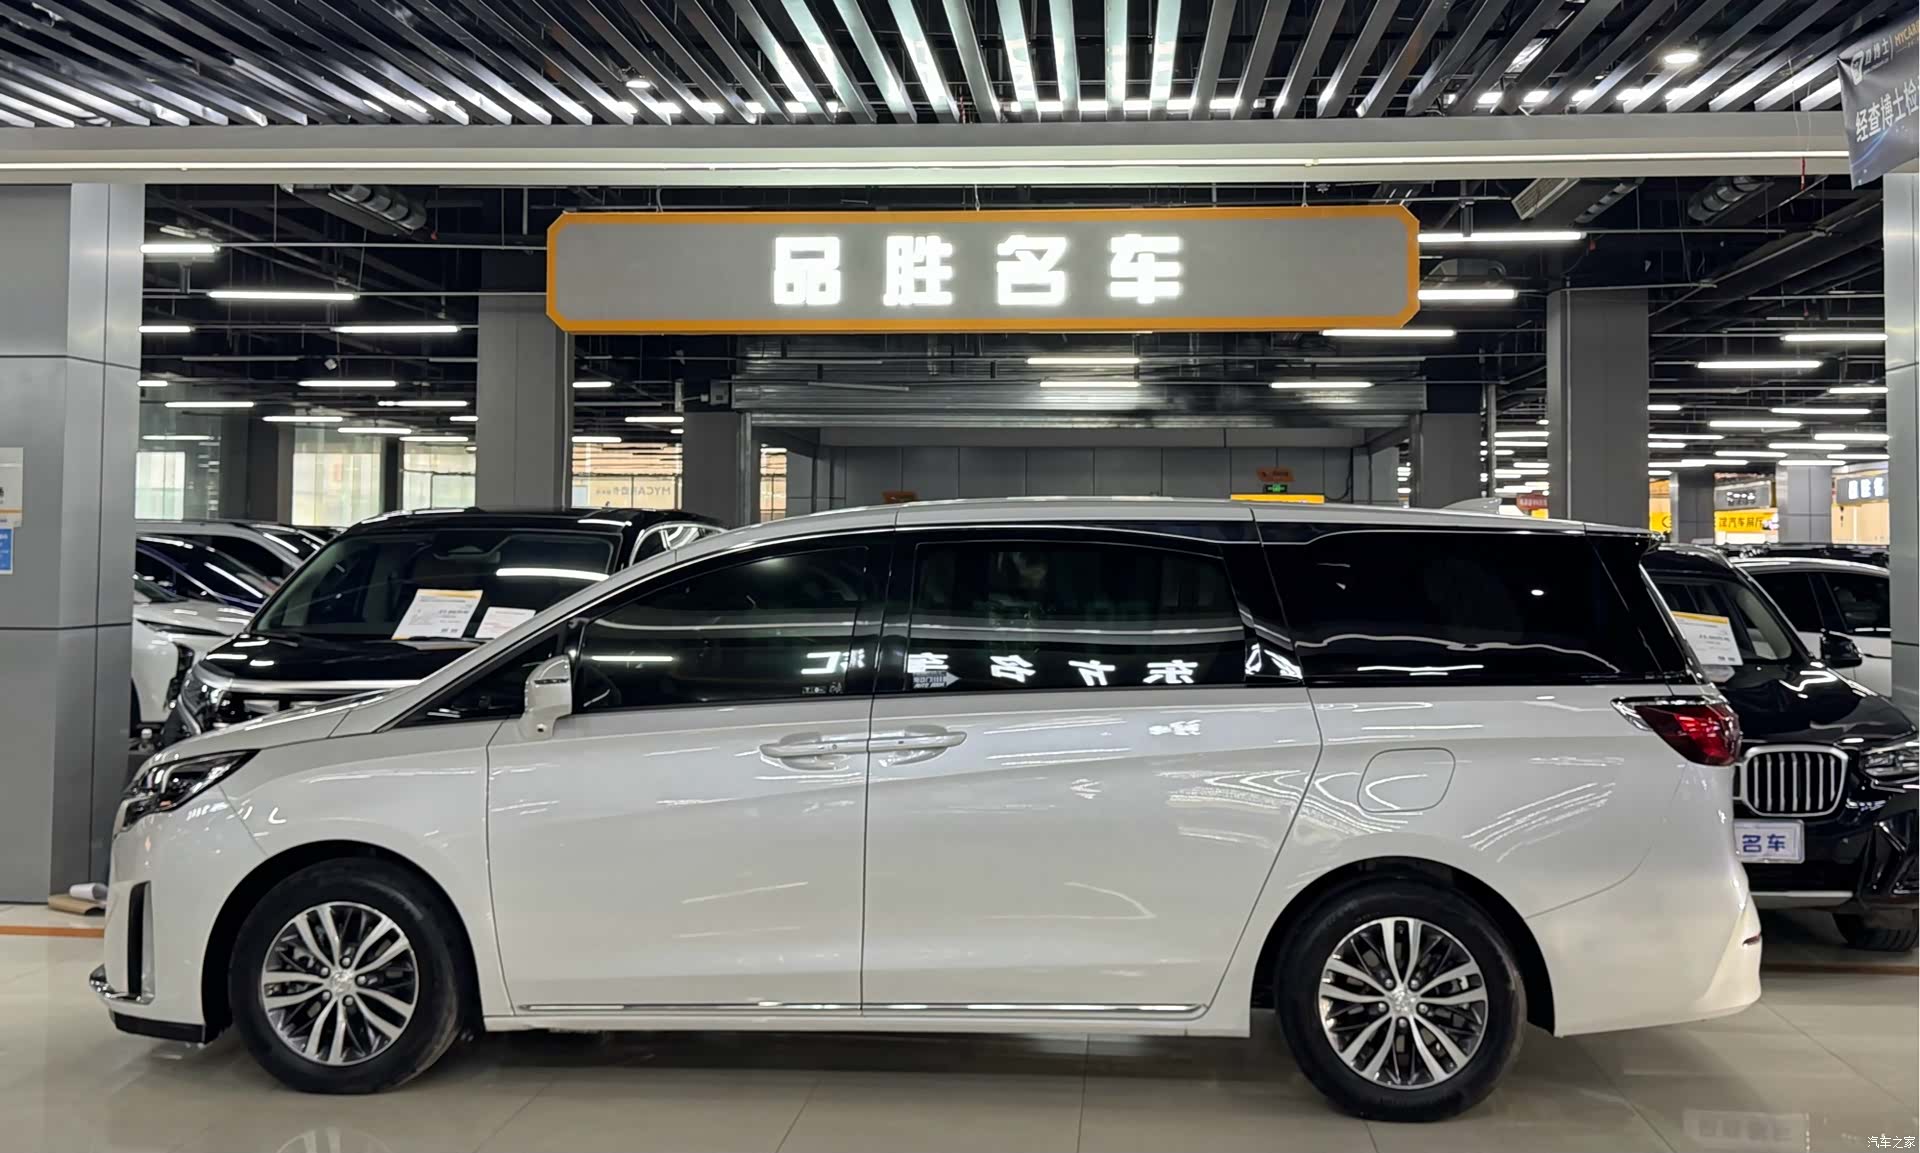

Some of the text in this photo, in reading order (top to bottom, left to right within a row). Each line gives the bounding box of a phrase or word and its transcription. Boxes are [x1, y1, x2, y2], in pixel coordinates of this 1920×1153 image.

[1856, 76, 1919, 142] 经查博士检
[773, 234, 1183, 305] 品胜名车
[1742, 833, 1786, 853] 名车
